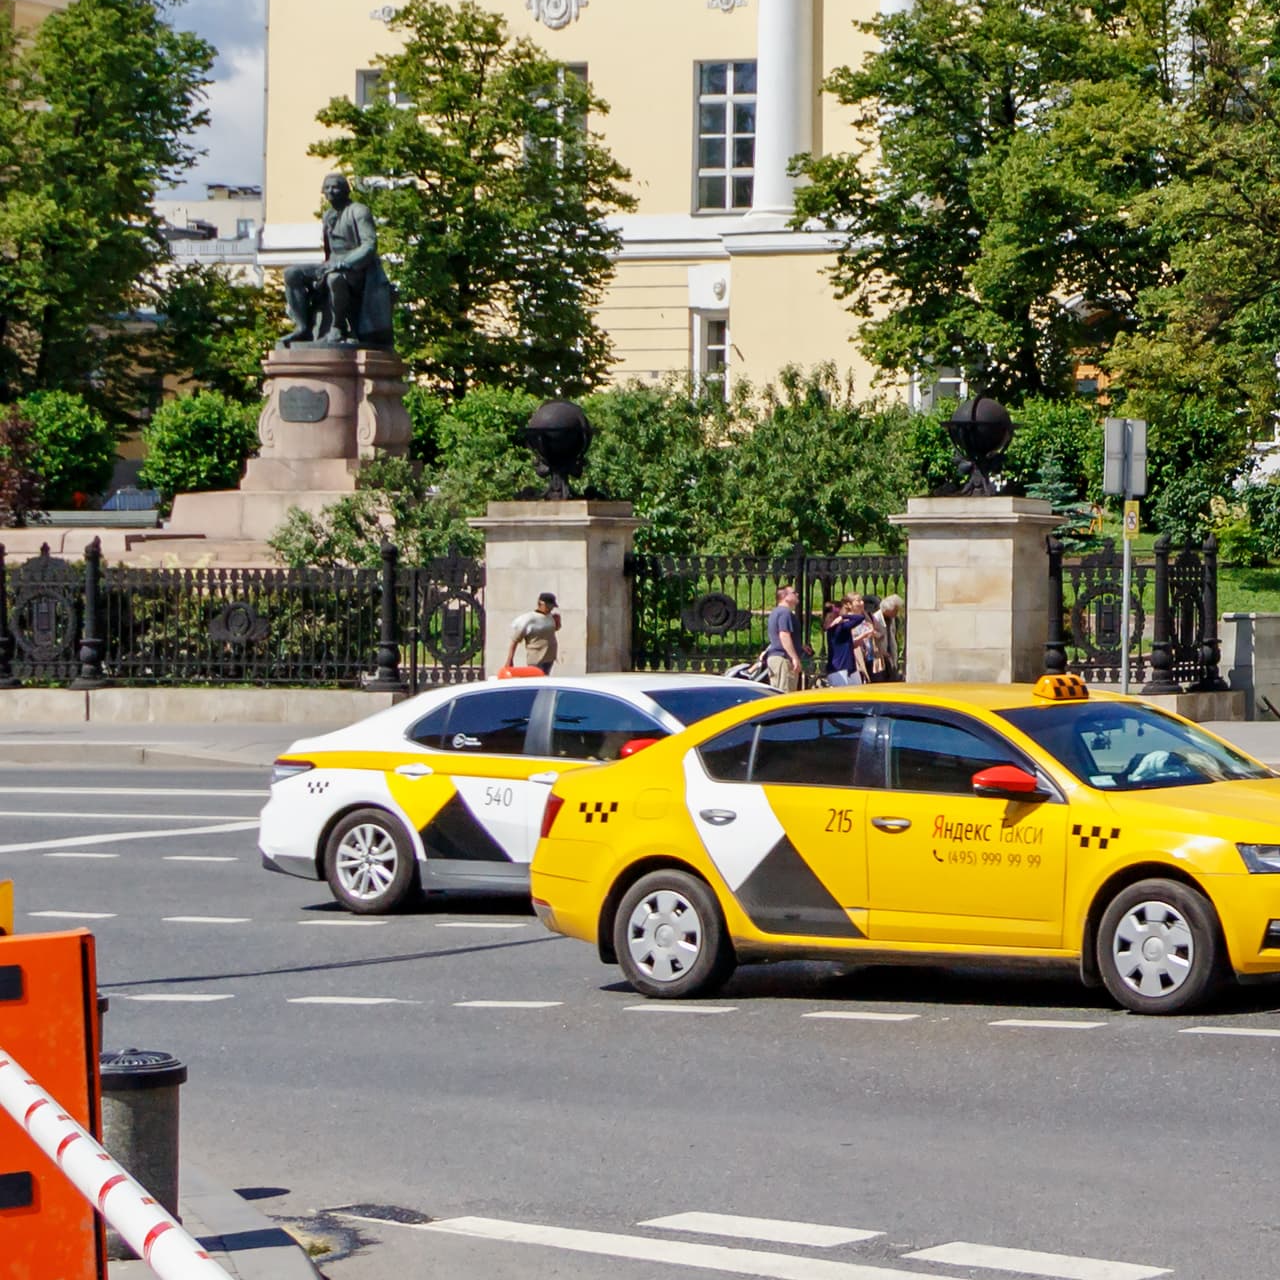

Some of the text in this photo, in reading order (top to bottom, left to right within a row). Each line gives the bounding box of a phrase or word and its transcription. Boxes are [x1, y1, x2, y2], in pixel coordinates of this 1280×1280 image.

[485, 786, 512, 807] 540
[825, 808, 853, 833] 215
[932, 814, 1044, 845] Яндекс Такси
[948, 850, 1042, 869] (495) 999 99 99
